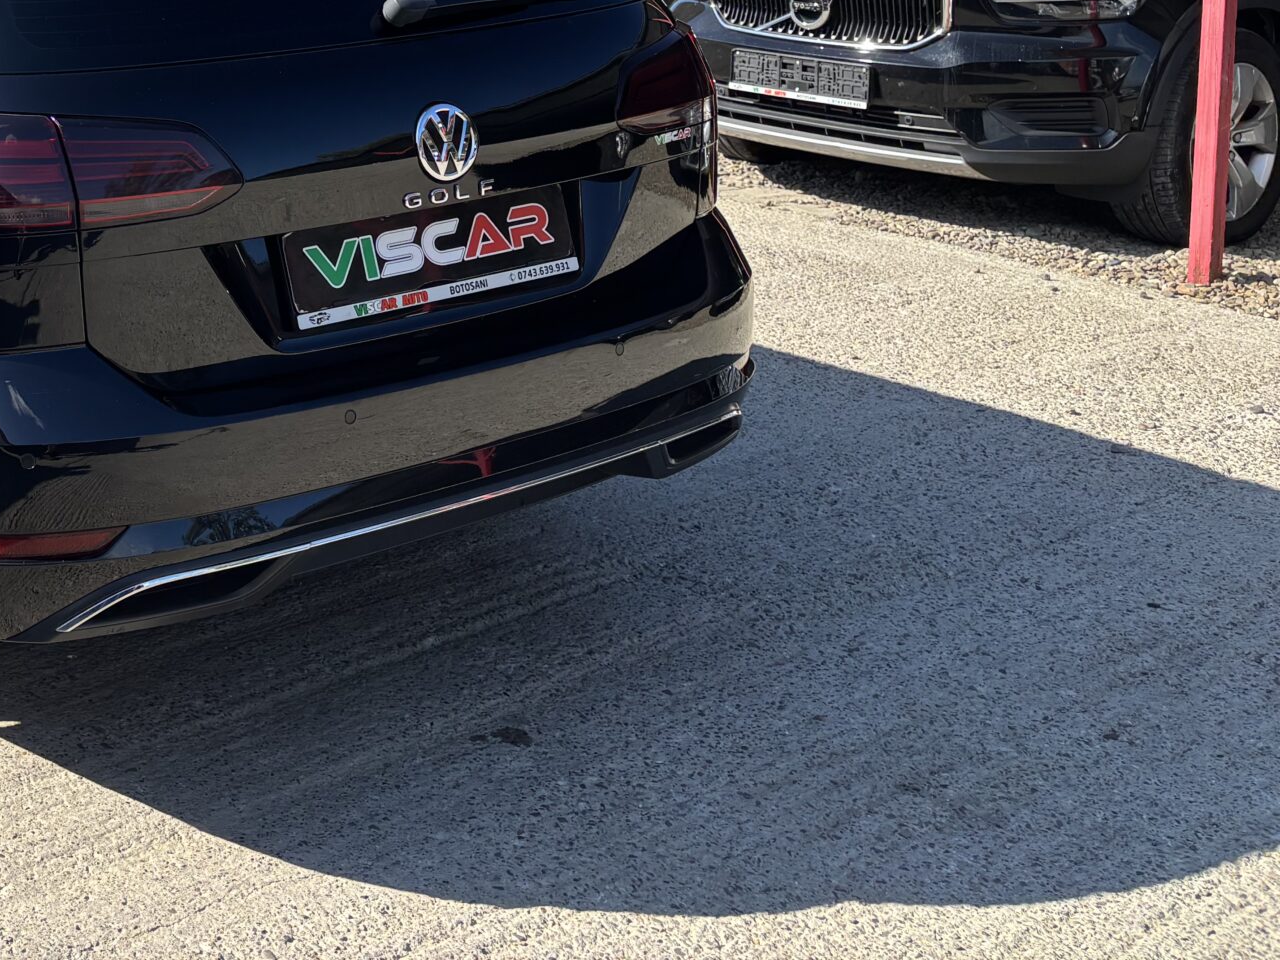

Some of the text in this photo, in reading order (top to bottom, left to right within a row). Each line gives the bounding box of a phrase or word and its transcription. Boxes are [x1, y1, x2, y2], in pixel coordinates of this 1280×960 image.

[654, 127, 692, 146] VISCAR
[403, 178, 495, 209] GOLF
[303, 202, 555, 289] VISCAR
[353, 261, 571, 317] VISCAR AUTO BOTOSANI 0743.639.931
